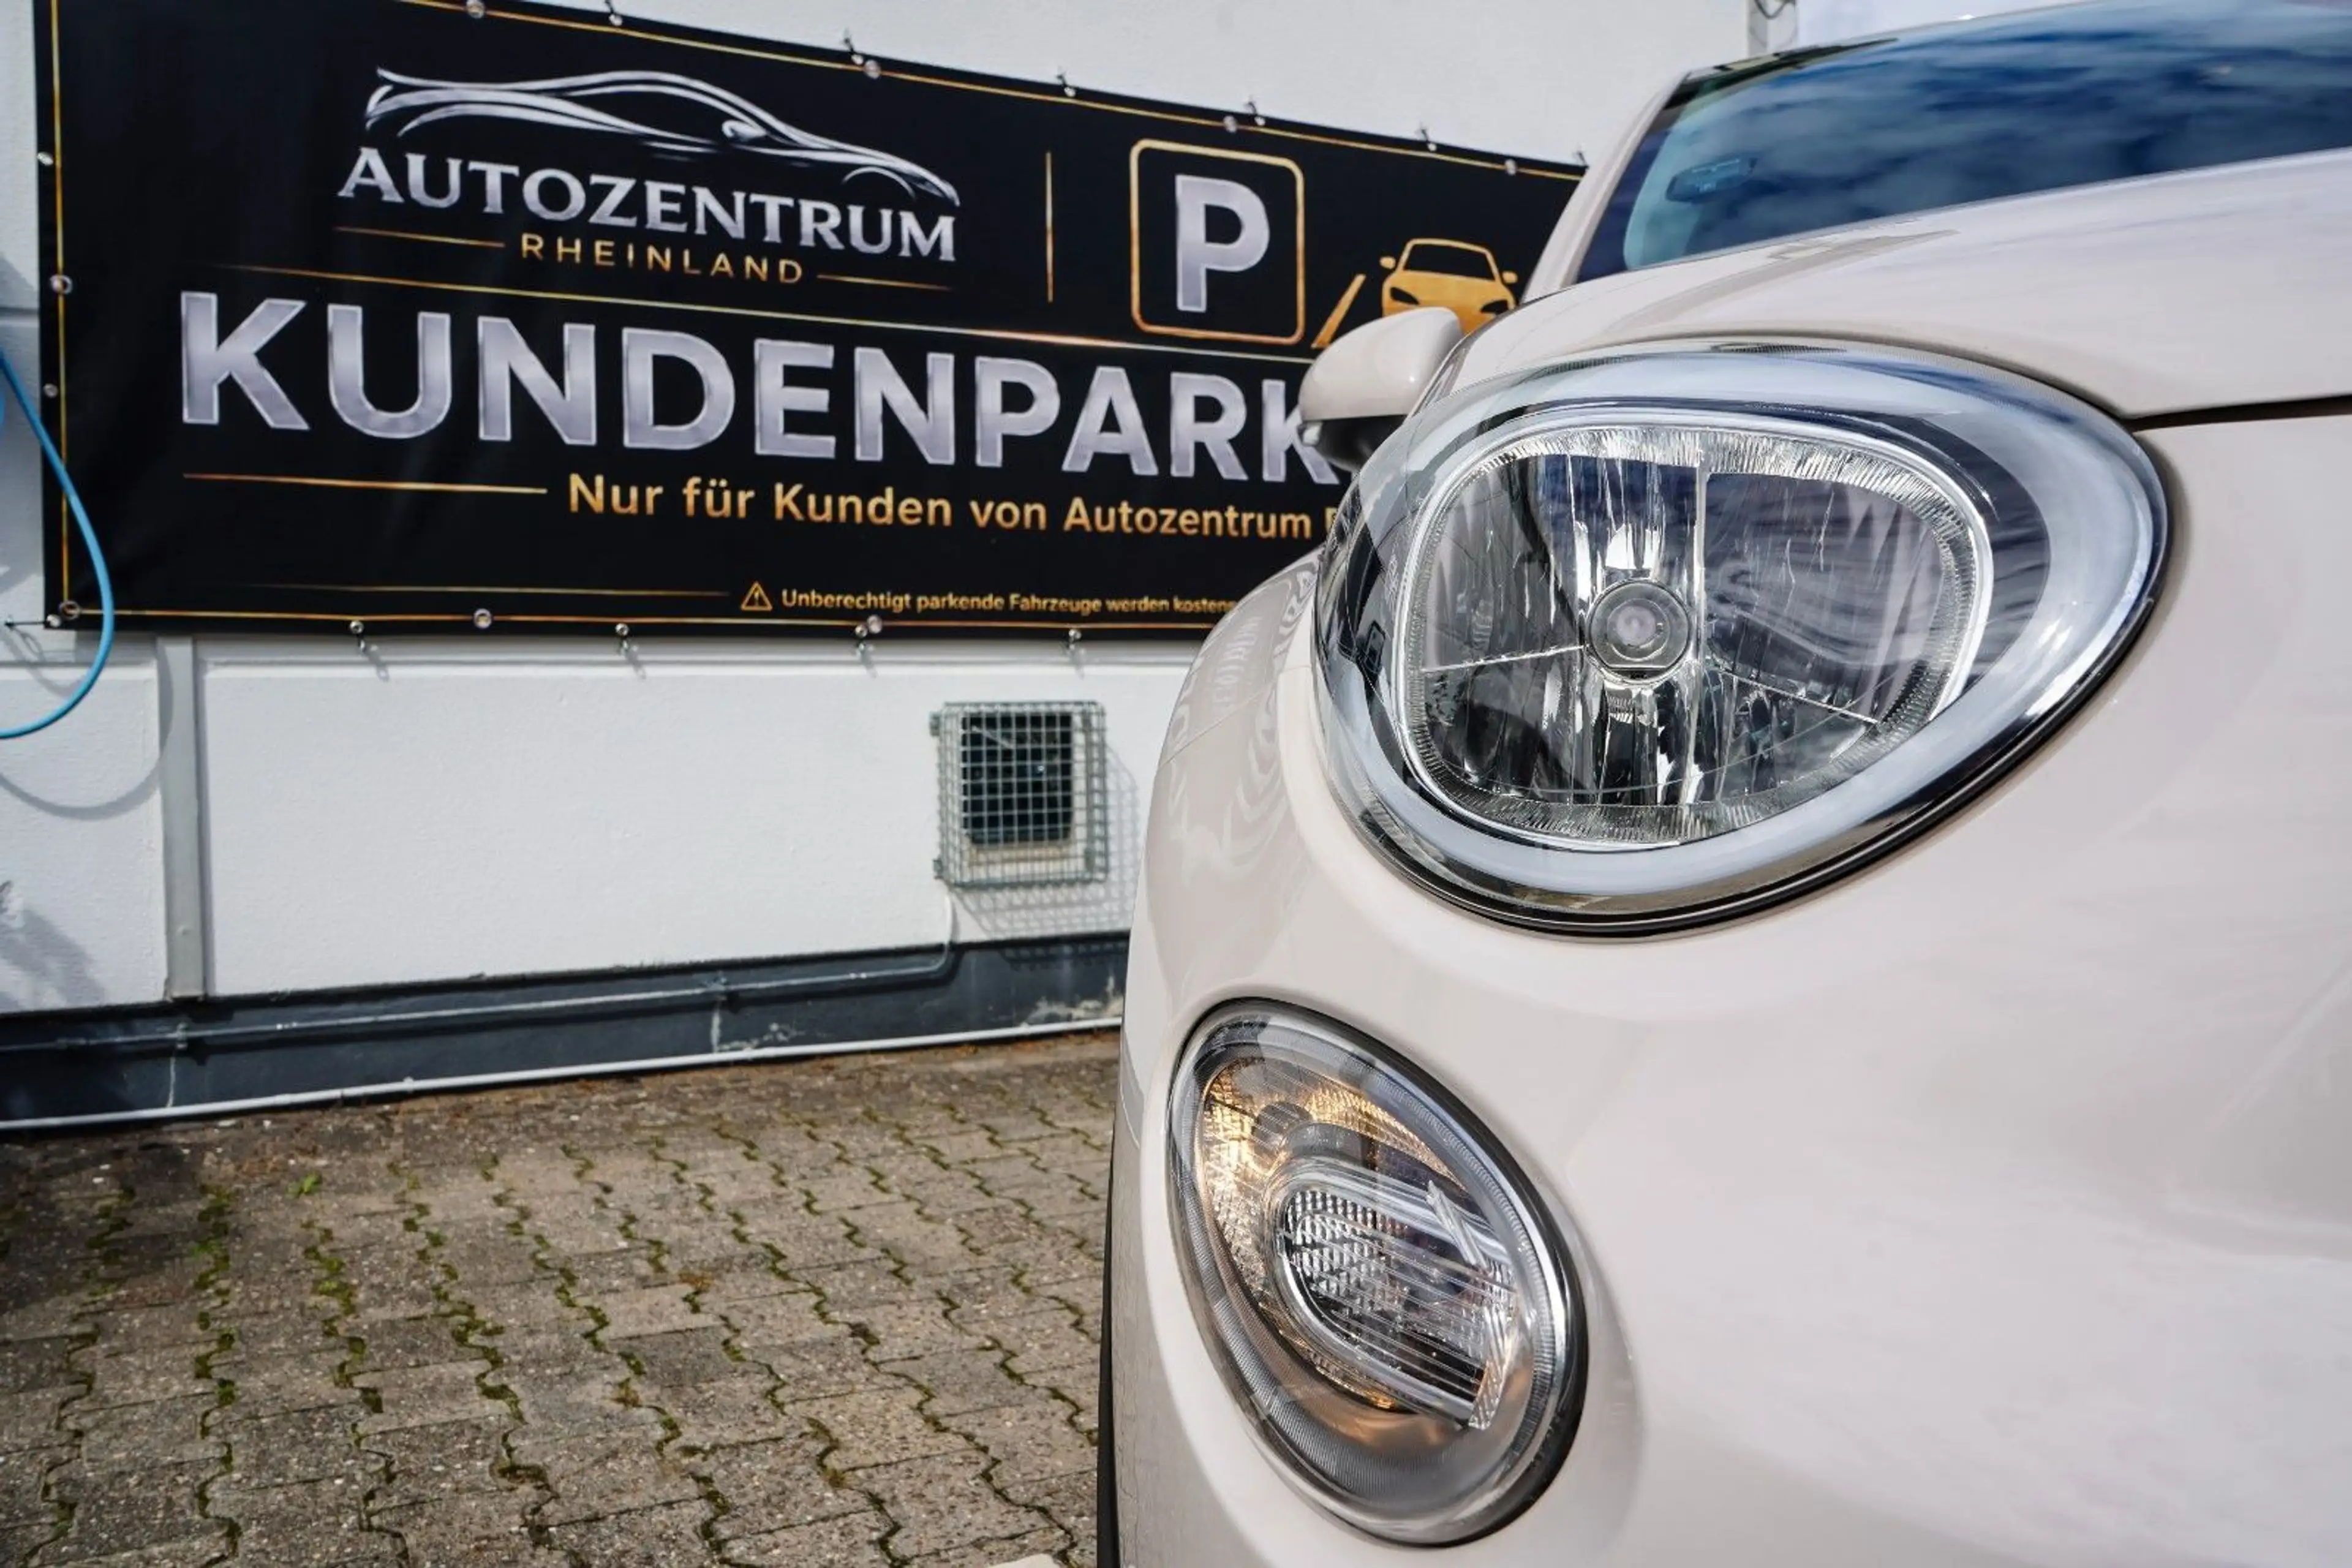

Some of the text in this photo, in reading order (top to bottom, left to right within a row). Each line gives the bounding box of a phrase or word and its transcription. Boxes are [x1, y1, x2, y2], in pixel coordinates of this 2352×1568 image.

[337, 146, 956, 262] AUTOZENTRUM
[521, 233, 802, 284] RHEINLAND
[1174, 174, 1270, 313] P
[570, 473, 663, 515] Nur
[682, 476, 756, 519] für
[774, 482, 952, 527] Kunden
[970, 500, 1047, 530] von
[1063, 497, 1312, 540] Autozentrum
[782, 589, 911, 613] Unberechtigt
[916, 592, 1005, 612] parkende
[1008, 593, 1102, 616] Fahrzeuge
[1105, 596, 1170, 612] werden
